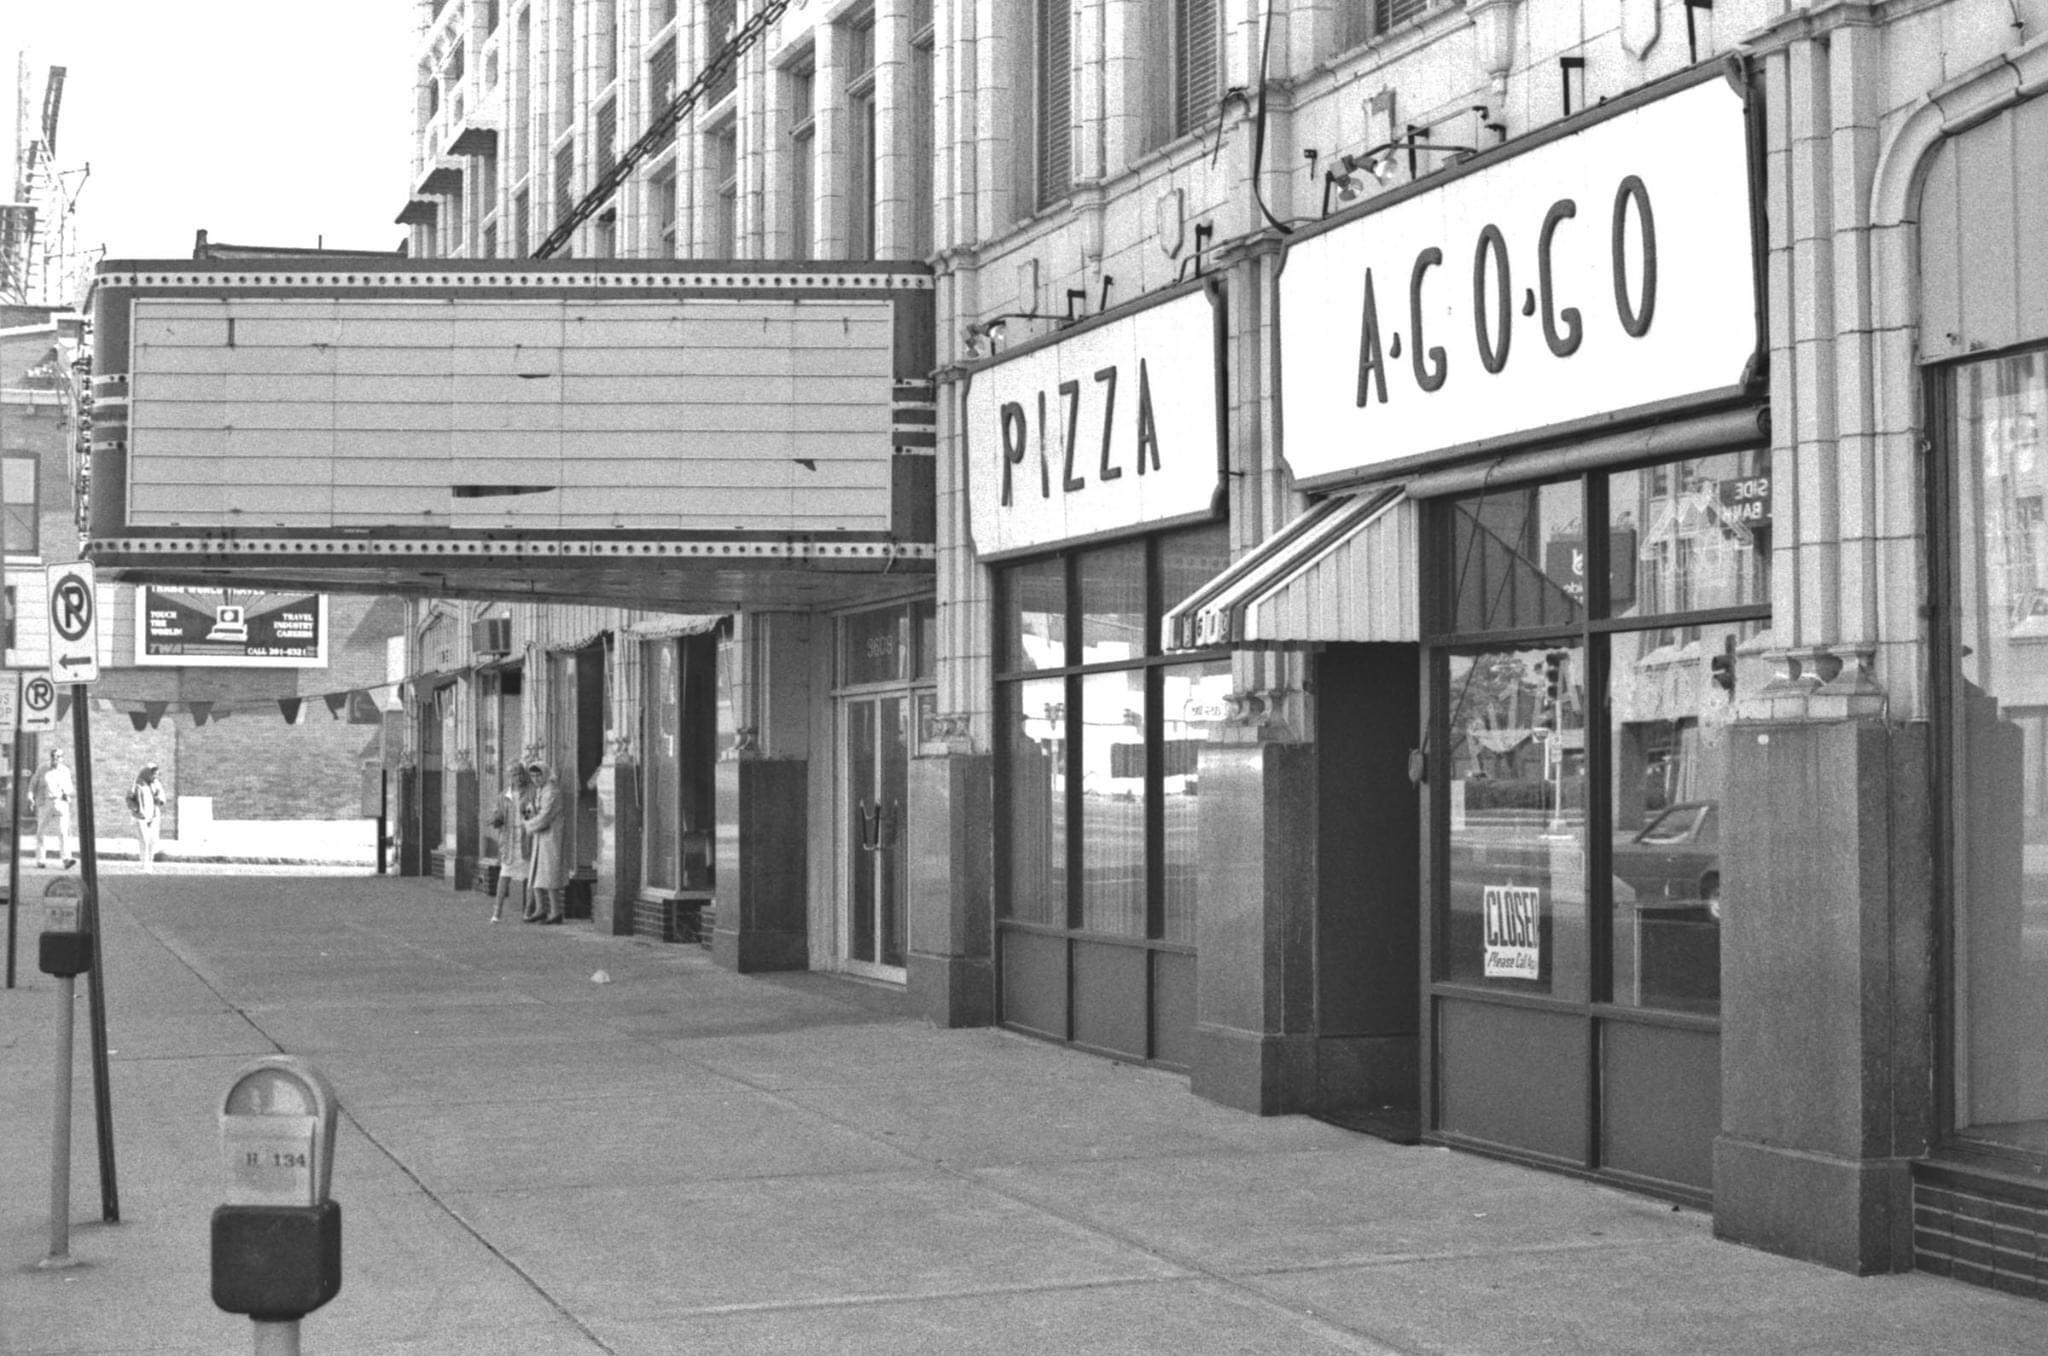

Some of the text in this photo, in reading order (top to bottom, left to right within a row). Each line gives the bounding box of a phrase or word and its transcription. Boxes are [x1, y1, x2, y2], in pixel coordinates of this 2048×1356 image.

[1001, 357, 1161, 507] PIZZA
[150, 611, 177, 619] TOUCH
[282, 613, 314, 621] TRAVEL
[150, 619, 167, 627] THE
[273, 621, 313, 630] INDUSTRY
[276, 630, 313, 638] CAREERS
[247, 647, 267, 656] CALL
[1486, 890, 1538, 949] CLOSED
[273, 1152, 306, 1169] 134
